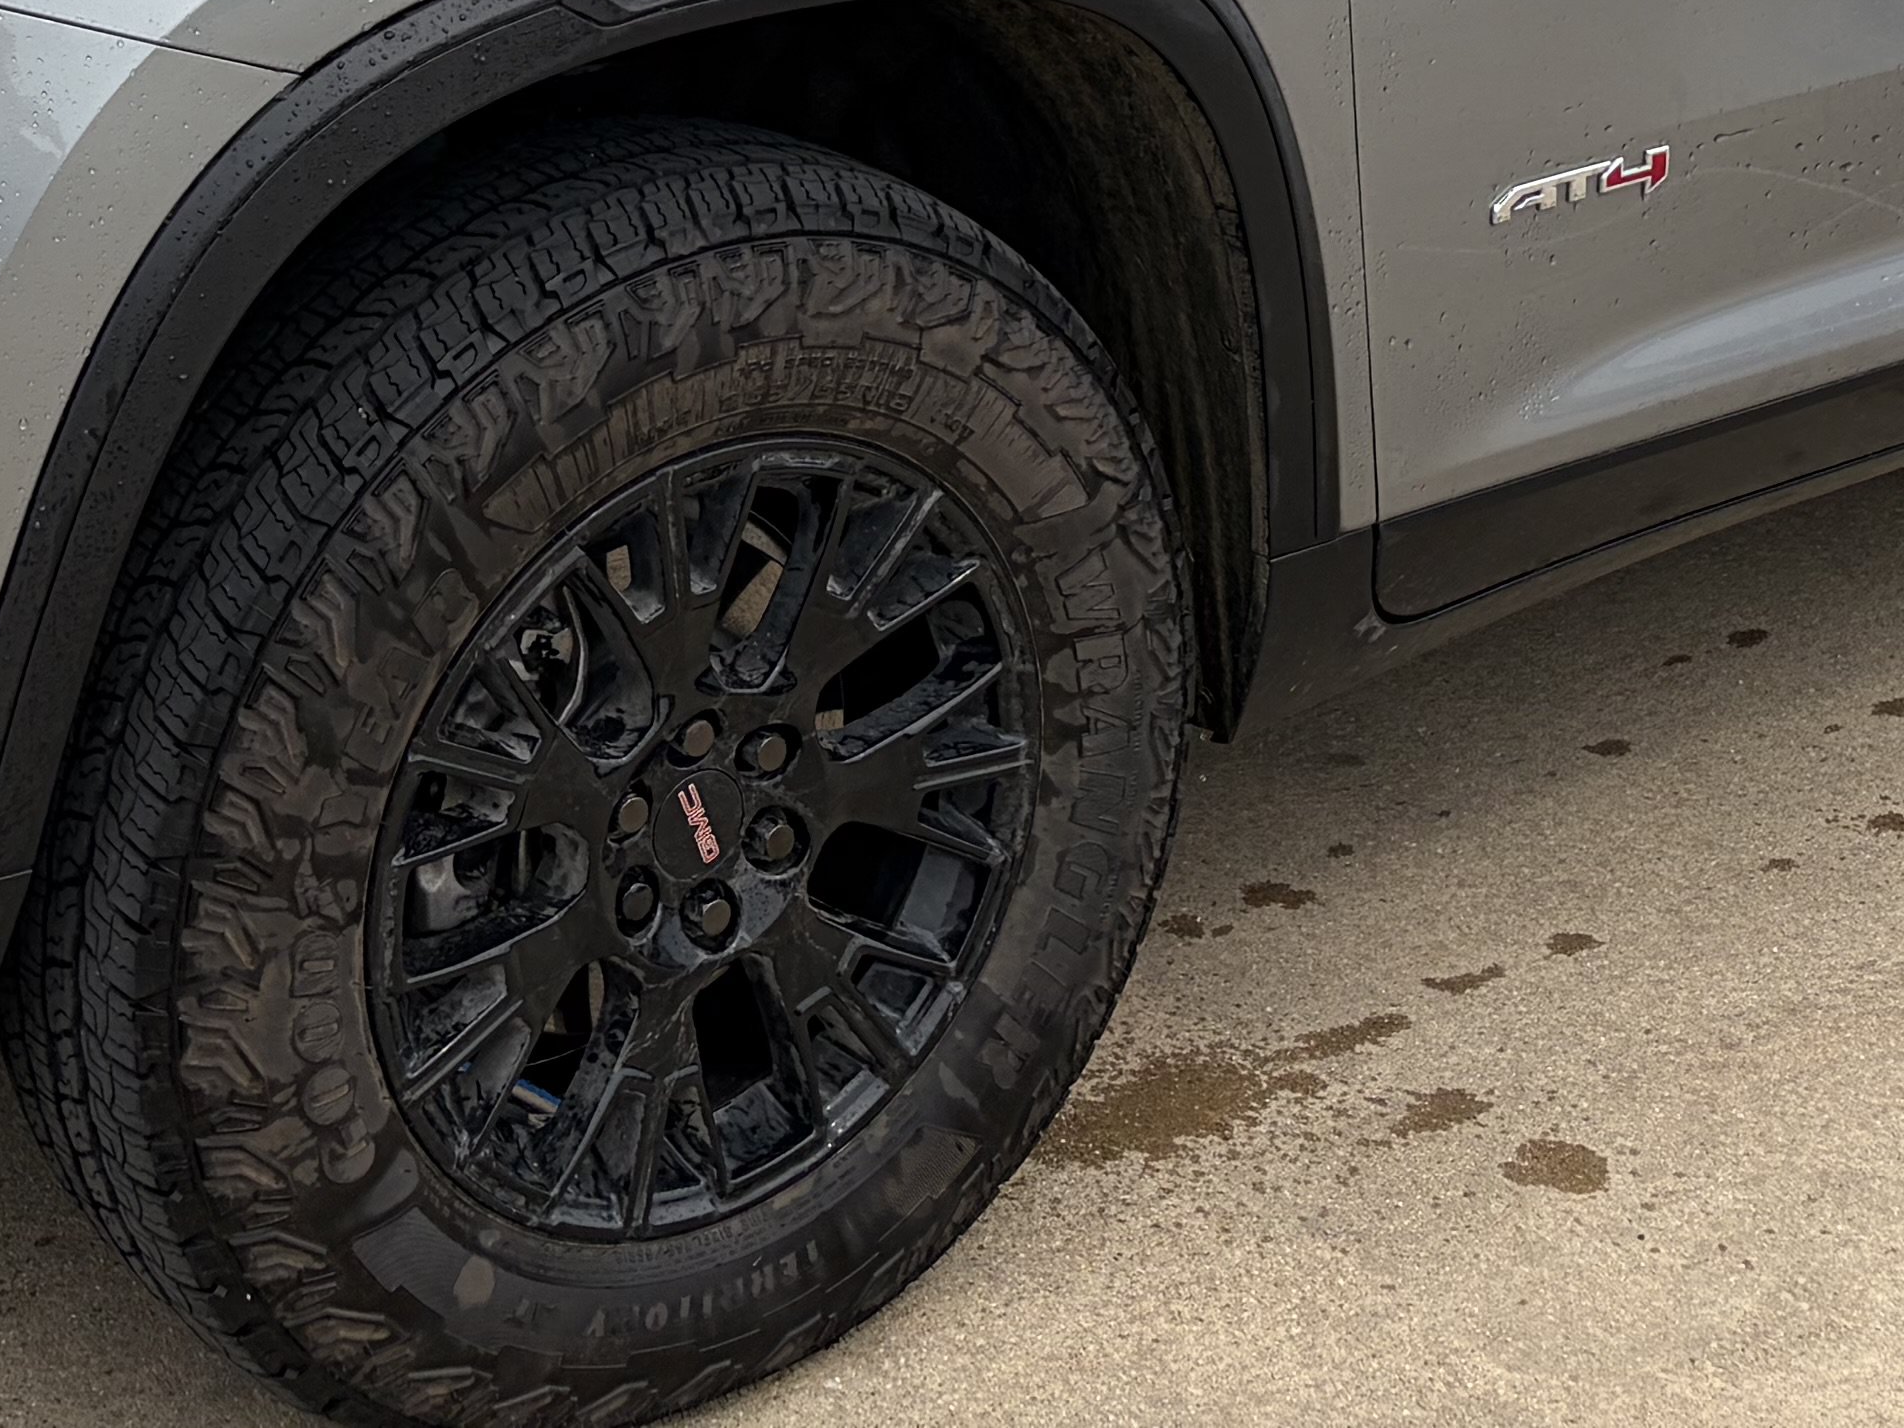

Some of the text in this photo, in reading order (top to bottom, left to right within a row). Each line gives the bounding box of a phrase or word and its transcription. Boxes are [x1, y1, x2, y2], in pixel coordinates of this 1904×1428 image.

[1489, 144, 1670, 225] AT4
[677, 782, 721, 865] GMC
[978, 545, 1133, 1089] WRANGLER
